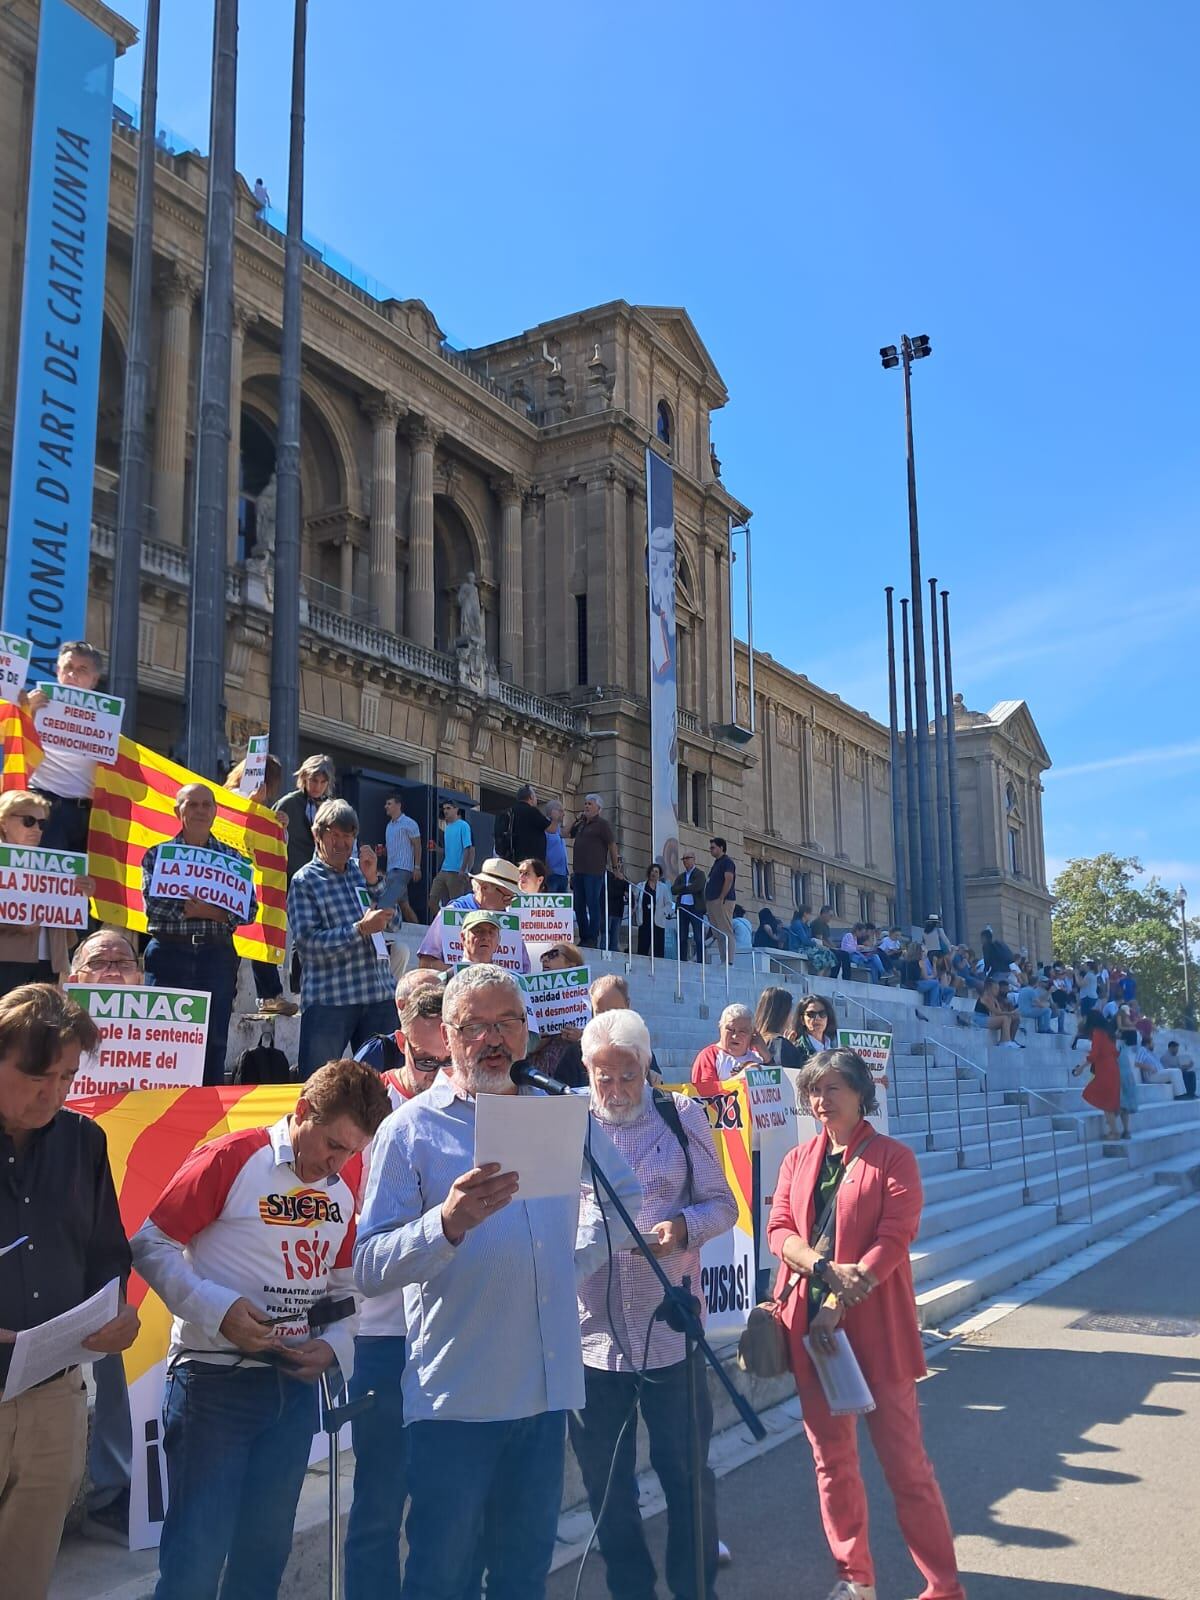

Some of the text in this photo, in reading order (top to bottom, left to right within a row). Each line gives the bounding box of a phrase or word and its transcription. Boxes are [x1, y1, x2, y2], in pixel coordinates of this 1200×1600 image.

[26, 126, 91, 688] ACIONAL D'ART DE CATALUNYA
[0, 636, 21, 656] AC
[7, 671, 19, 685] DE
[53, 686, 111, 713] MNAC
[64, 706, 97, 722] PIERDE
[42, 717, 113, 741] CREDIBILIDAD Y
[10, 850, 75, 873] MNAC
[174, 847, 241, 874] MNAC
[0, 871, 17, 890] LA
[161, 862, 247, 895] LA JUSTICIA
[157, 883, 244, 915] NOS IGUALA
[521, 896, 564, 908] MNAC
[0, 901, 83, 925] NOS IGUALA
[526, 972, 579, 991] MNAC
[530, 986, 588, 1003] pacidad técnica
[89, 992, 194, 1022] MNAC
[536, 1009, 543, 1018] el
[545, 1001, 587, 1016] desmontaje
[100, 1024, 204, 1045] ple la sentencia
[849, 1033, 886, 1048] MNAC
[100, 1050, 177, 1070] FIRME del
[72, 1075, 134, 1095] ribunal
[752, 1070, 776, 1086] MNAC
[701, 1254, 749, 1314] cusas!
